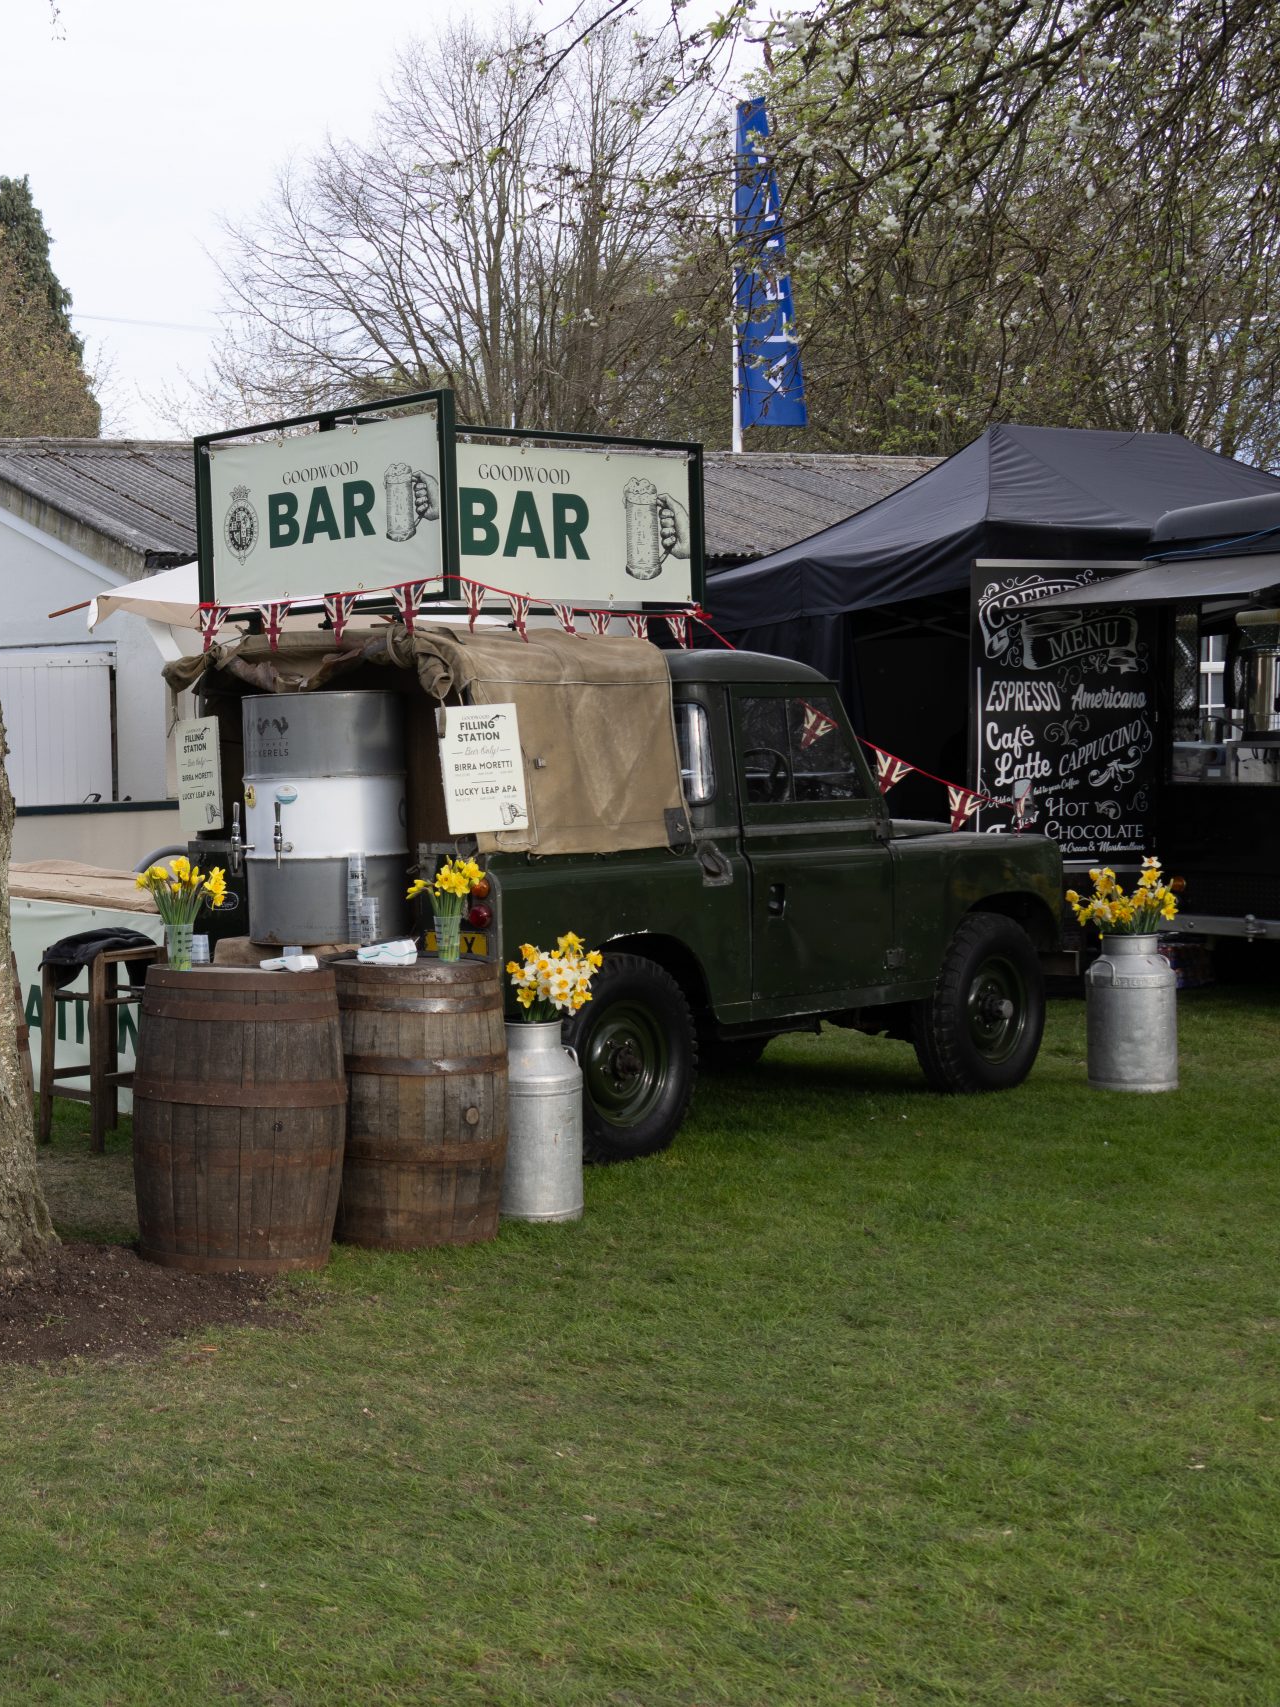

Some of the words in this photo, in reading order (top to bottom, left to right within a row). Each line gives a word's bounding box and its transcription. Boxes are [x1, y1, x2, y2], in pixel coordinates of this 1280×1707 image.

[282, 460, 359, 485] GOODWOOD
[478, 463, 571, 486] GOODWOOD
[268, 479, 376, 549] BAR
[459, 486, 590, 561] BAR
[1047, 620, 1120, 661] MENU
[985, 680, 1062, 712] ESPRESSO
[1071, 683, 1147, 711] Americano
[460, 720, 495, 731] FILLING
[185, 733, 204, 743] FILLING
[457, 731, 500, 743] STATION
[986, 721, 1035, 759] Café
[184, 743, 206, 753] STATION
[994, 751, 1053, 787] Latte
[1058, 719, 1142, 777] CAPPUCCINO
[454, 763, 477, 772] BIRRA
[479, 760, 513, 770] MORETTI
[454, 787, 479, 797] LUCKY
[481, 785, 500, 795] LEAP
[502, 784, 517, 793] APA
[1045, 797, 1089, 817] HOT
[1044, 820, 1144, 840] CHOCOLATE
[1088, 840, 1096, 852] &
